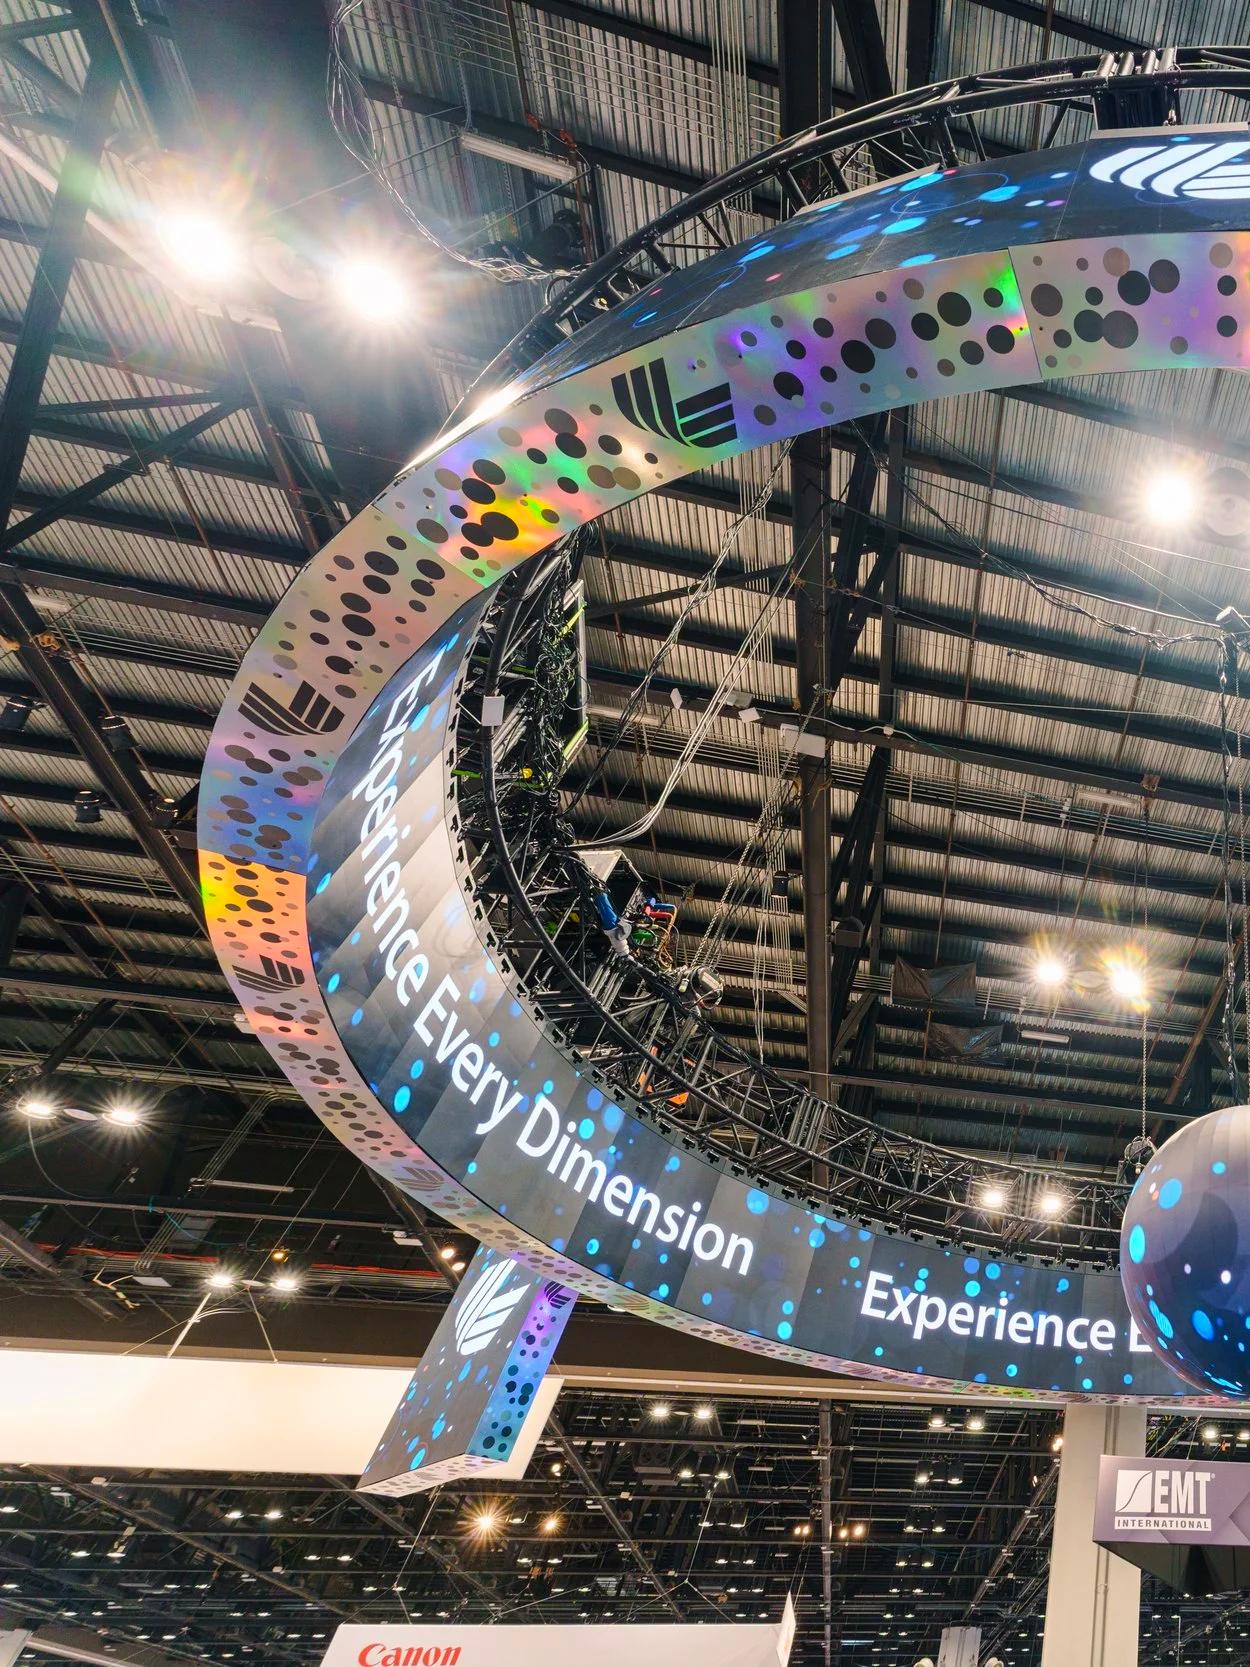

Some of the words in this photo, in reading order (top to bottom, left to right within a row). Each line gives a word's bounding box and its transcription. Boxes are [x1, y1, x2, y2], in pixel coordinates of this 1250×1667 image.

[352, 645, 447, 1006] Experience
[413, 971, 525, 1136] Every
[516, 1091, 756, 1276] Dimension
[860, 1270, 1115, 1353] Experience
[1117, 1519, 1209, 1530] INTERNATIONAL
[357, 1643, 462, 1667] Canon
